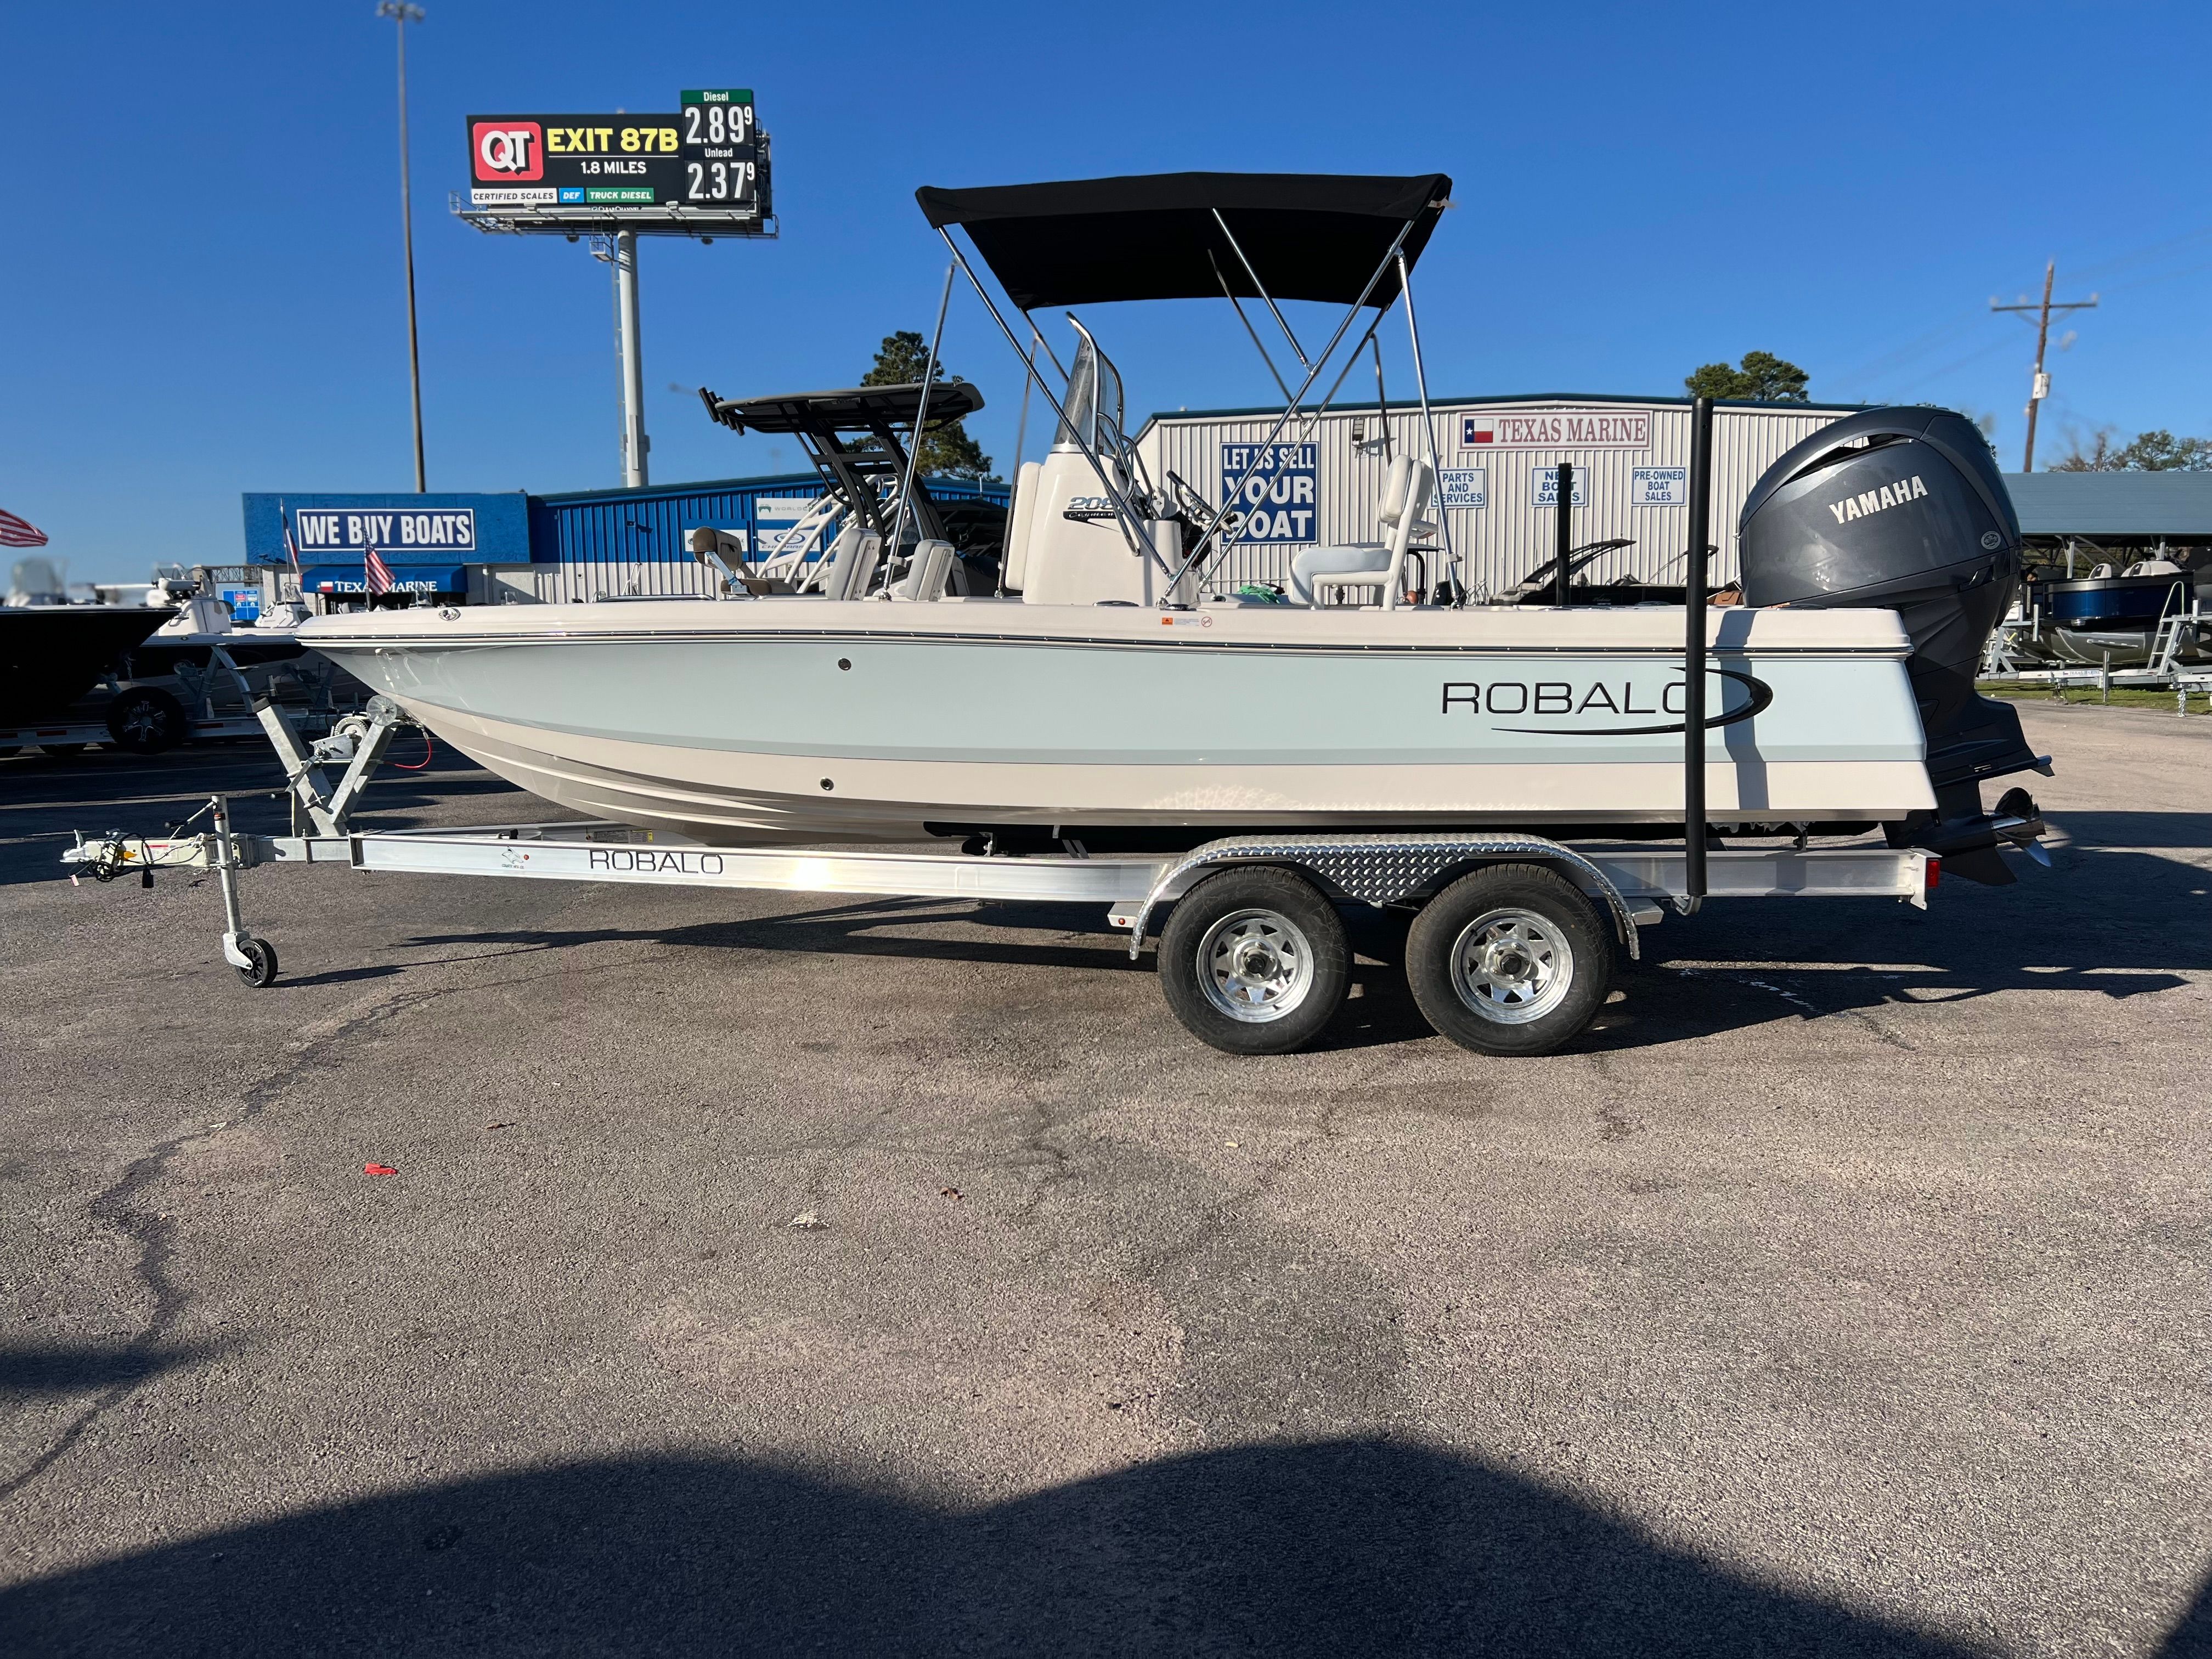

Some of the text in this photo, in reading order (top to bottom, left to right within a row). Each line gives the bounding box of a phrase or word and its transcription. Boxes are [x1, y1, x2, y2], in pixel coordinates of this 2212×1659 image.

[703, 92, 729, 101] Diesel
[547, 128, 679, 152] EXIT 87B
[481, 130, 531, 172] QT
[704, 148, 733, 157] Unlead
[581, 161, 646, 174] 1.8 MILES
[1499, 417, 1646, 443] TEXAS MARINE
[1223, 448, 1249, 470] LET
[1279, 447, 1314, 469] SELL
[1442, 472, 1474, 482] PARTS
[1634, 471, 1683, 480] PRE-OWNED
[1224, 476, 1314, 504] YOUR
[1448, 483, 1469, 492] AND
[1542, 482, 1577, 491] BOT
[1647, 481, 1670, 490] BOAT
[1538, 492, 1580, 501] SAS
[1645, 492, 1672, 501] SALES
[1829, 475, 1928, 524] YAMAHA
[302, 515, 470, 544] WE BUY BOATS
[335, 581, 373, 592] TEXA
[589, 849, 723, 874] ROBALO
